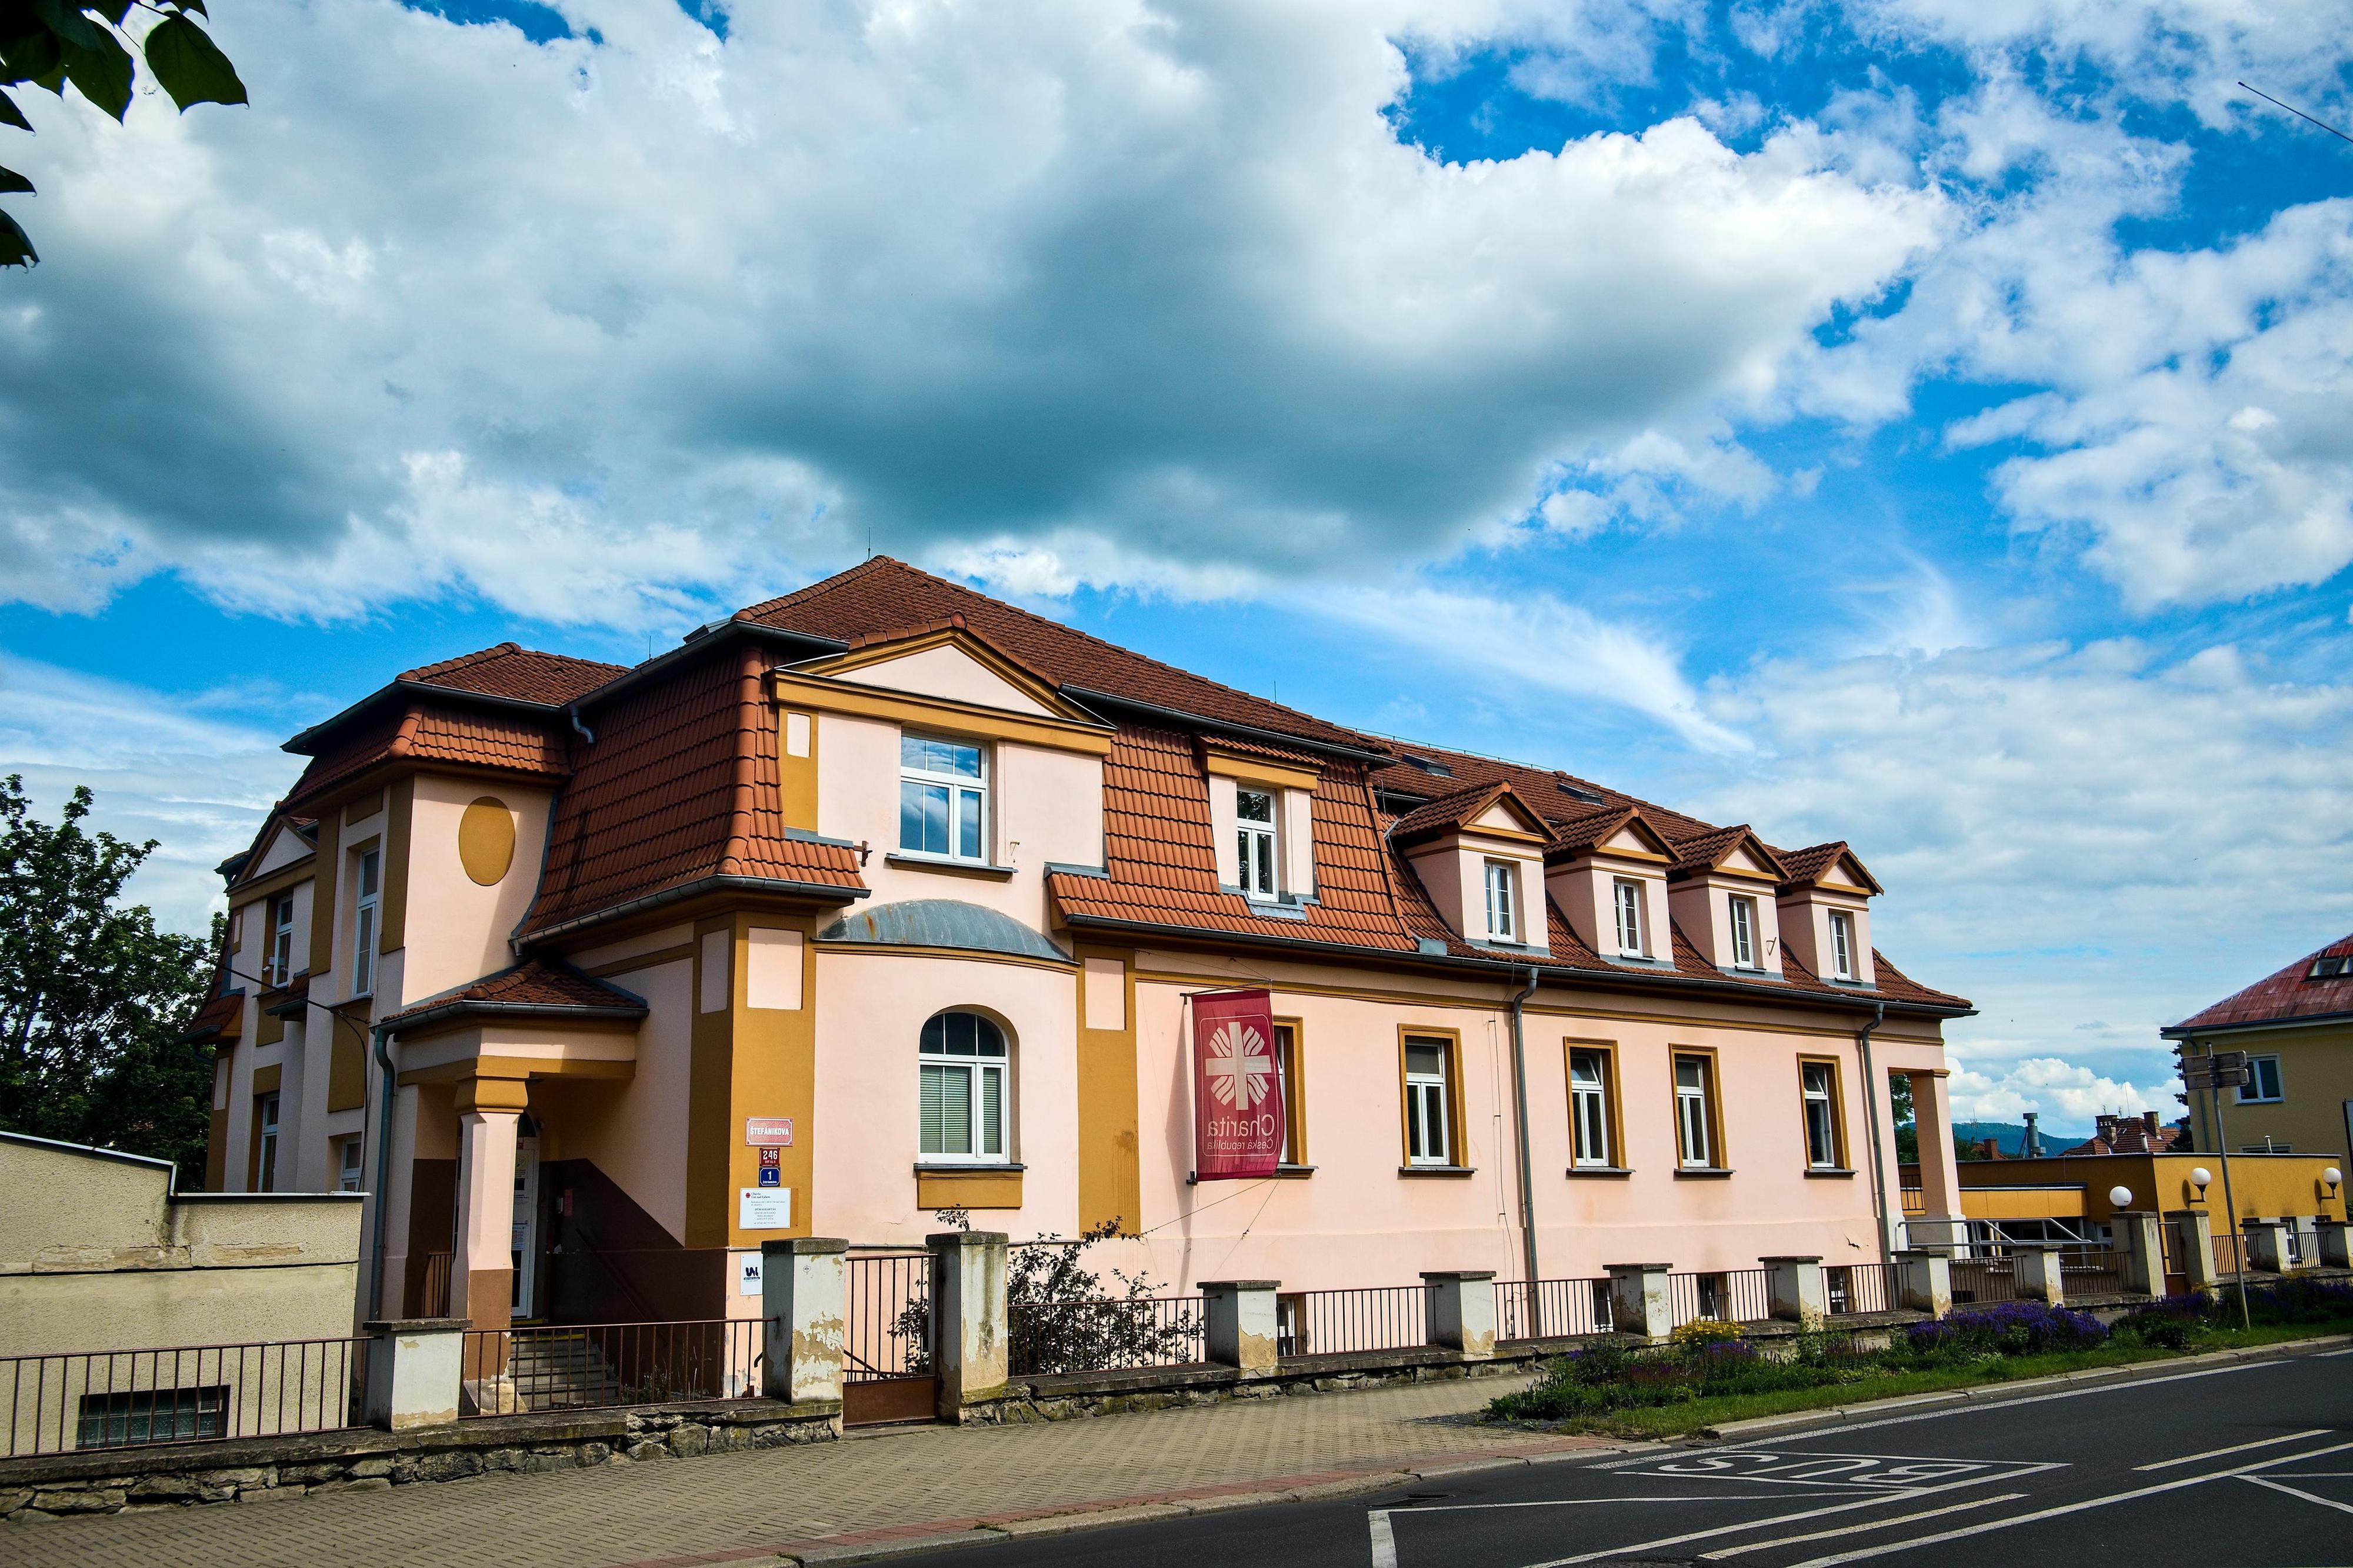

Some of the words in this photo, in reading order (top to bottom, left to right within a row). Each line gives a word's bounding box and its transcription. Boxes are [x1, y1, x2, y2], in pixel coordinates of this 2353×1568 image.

[751, 1126, 789, 1135] ŠTEFÁNIKOVA
[763, 1150, 778, 1160] 246
[768, 1170, 772, 1180] 1
[1658, 1454, 1993, 1484] BUS
